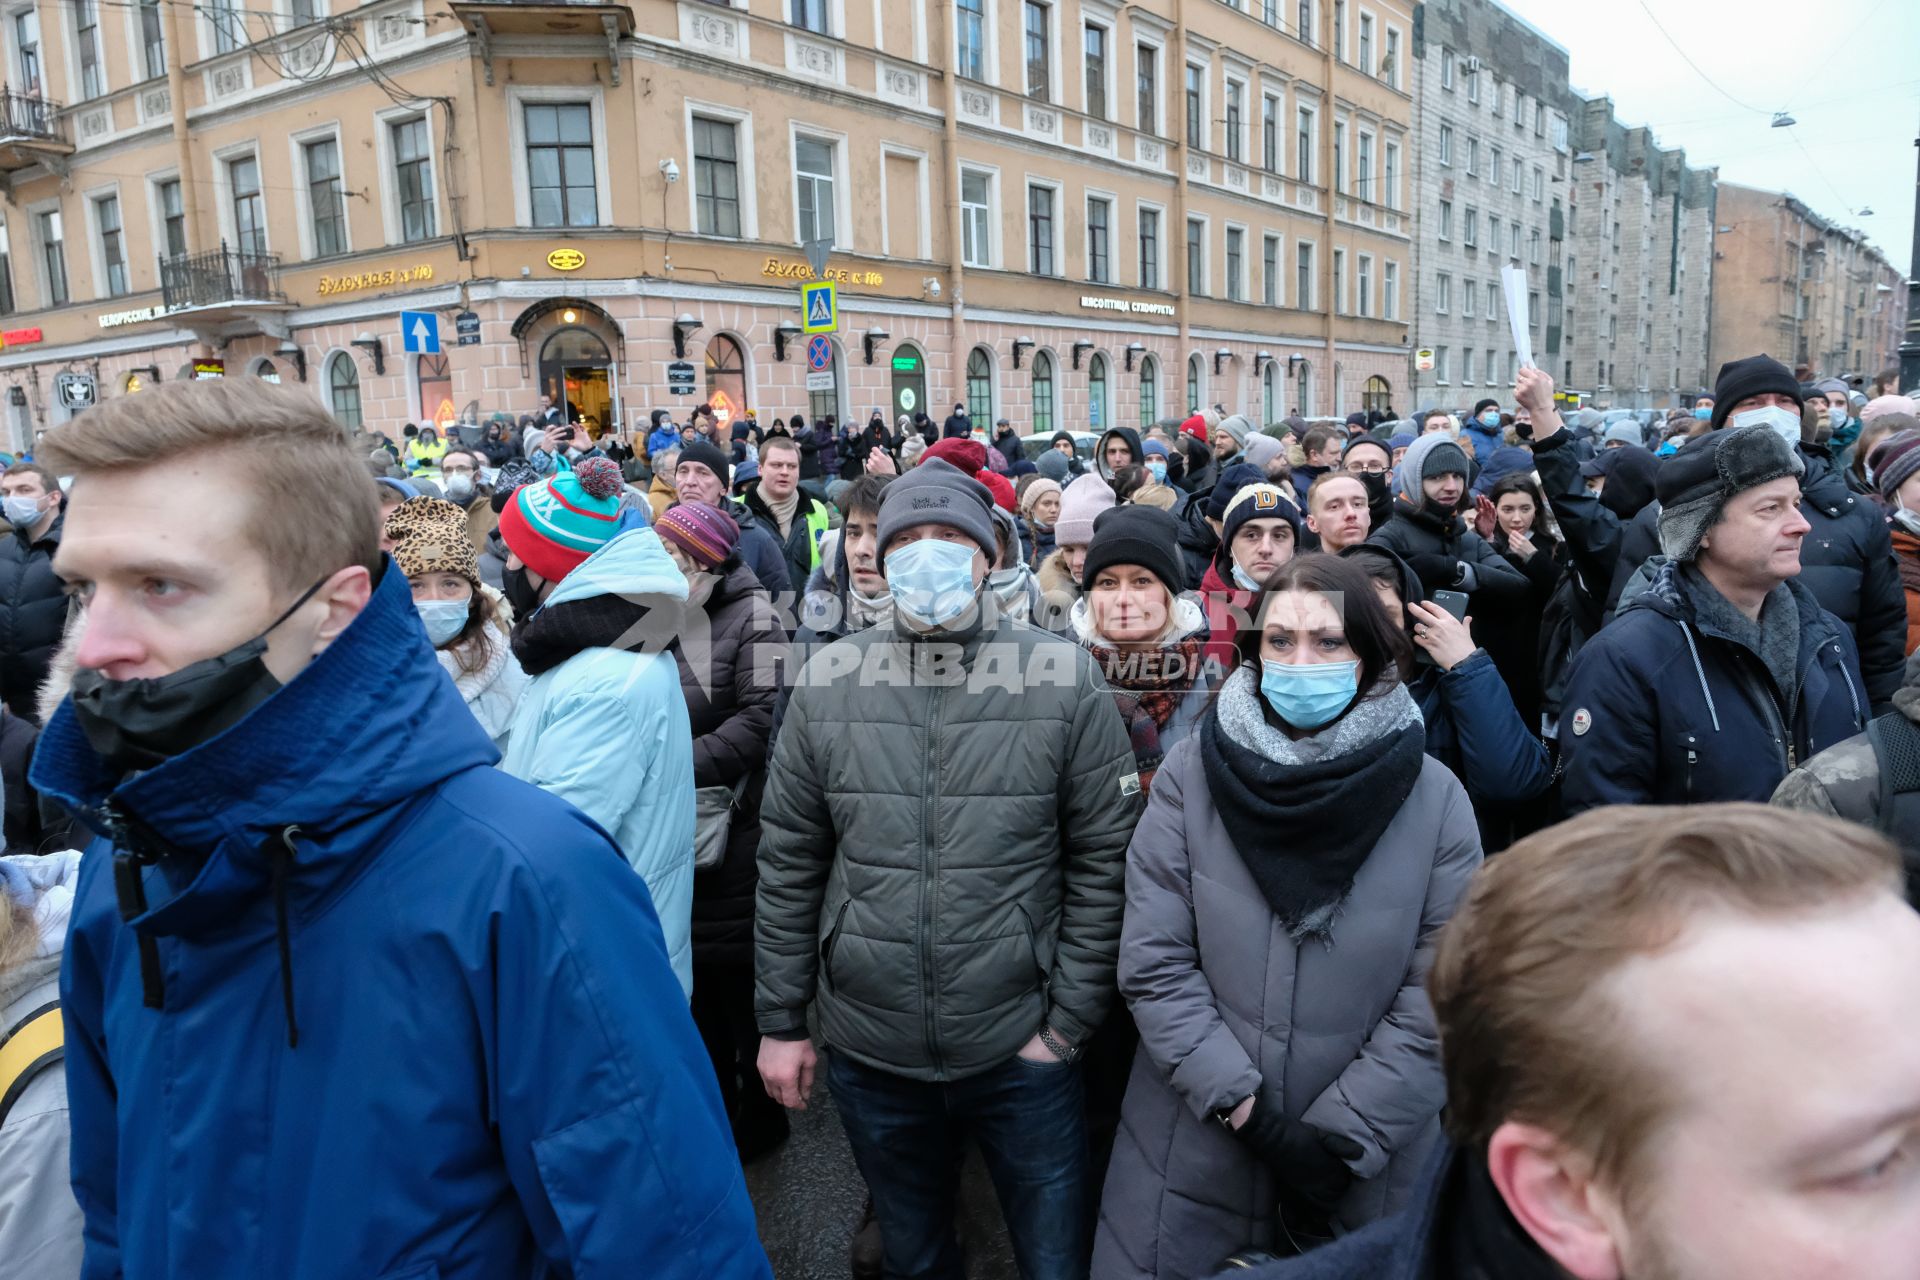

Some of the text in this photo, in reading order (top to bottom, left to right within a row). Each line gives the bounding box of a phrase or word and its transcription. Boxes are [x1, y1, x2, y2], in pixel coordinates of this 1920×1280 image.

[762, 258, 848, 282] Булочая
[317, 270, 394, 295] Булочная
[1131, 302, 1175, 315] СУХОФРУКТЫ
[1254, 490, 1278, 510] D
